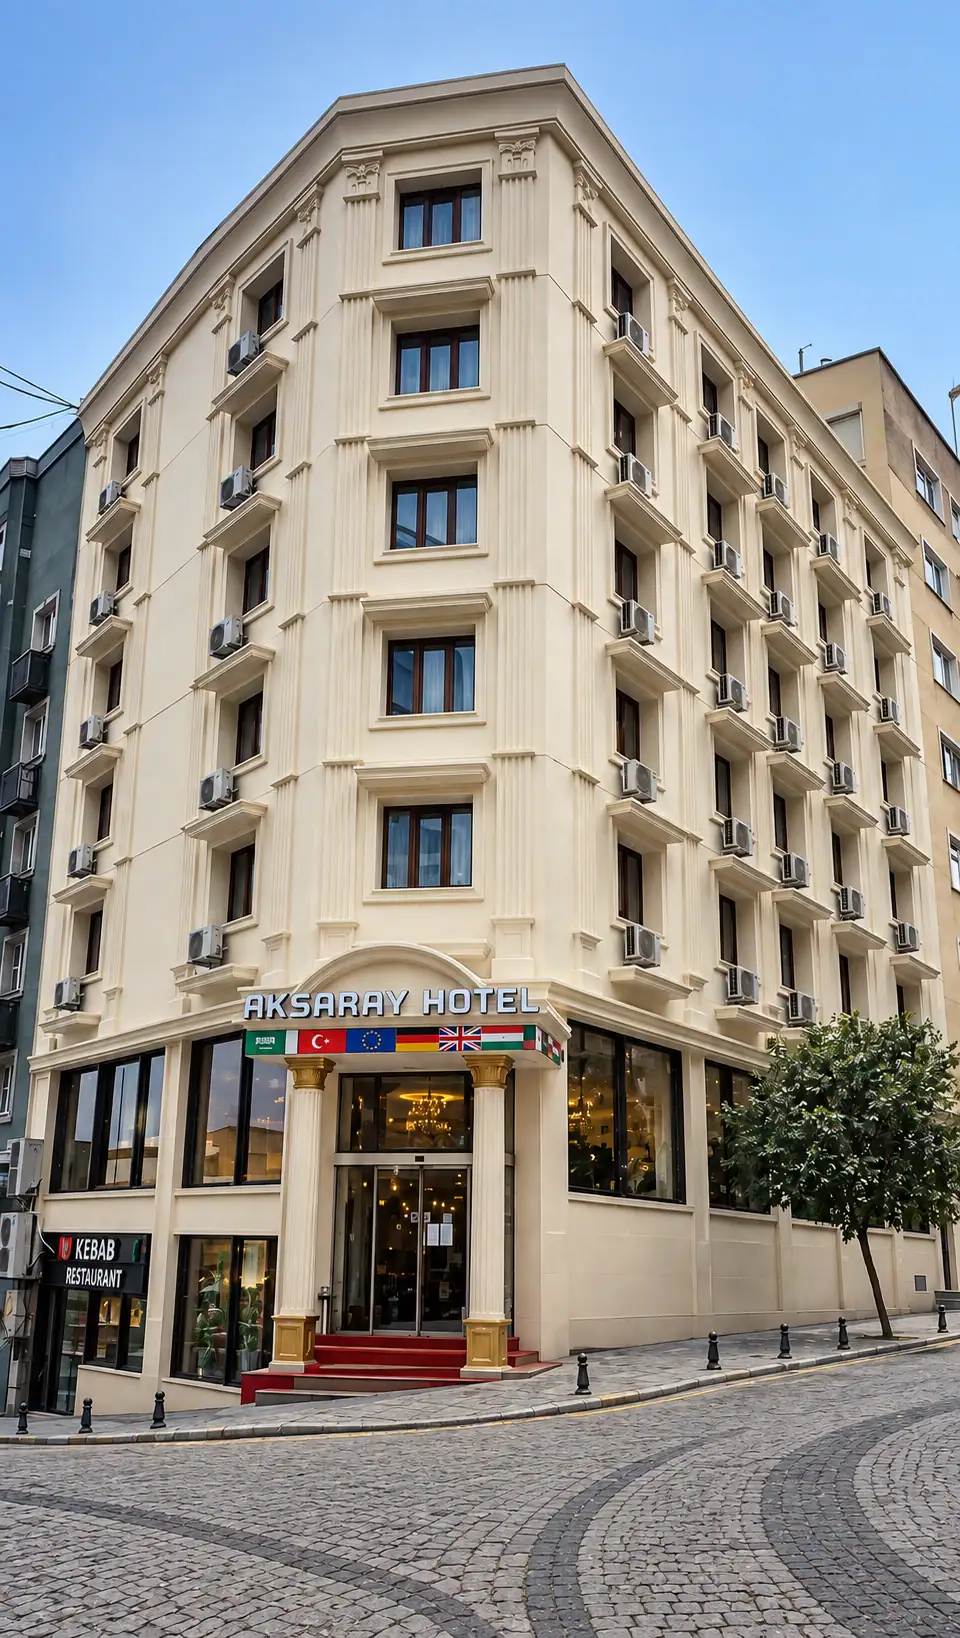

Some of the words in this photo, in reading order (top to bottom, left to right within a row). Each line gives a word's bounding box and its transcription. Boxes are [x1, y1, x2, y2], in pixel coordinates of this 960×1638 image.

[243, 989, 409, 1019] AKSARAY
[423, 987, 540, 1015] HOTEL
[75, 1238, 116, 1261] KEBAB
[65, 1267, 123, 1288] RESTAURANT
